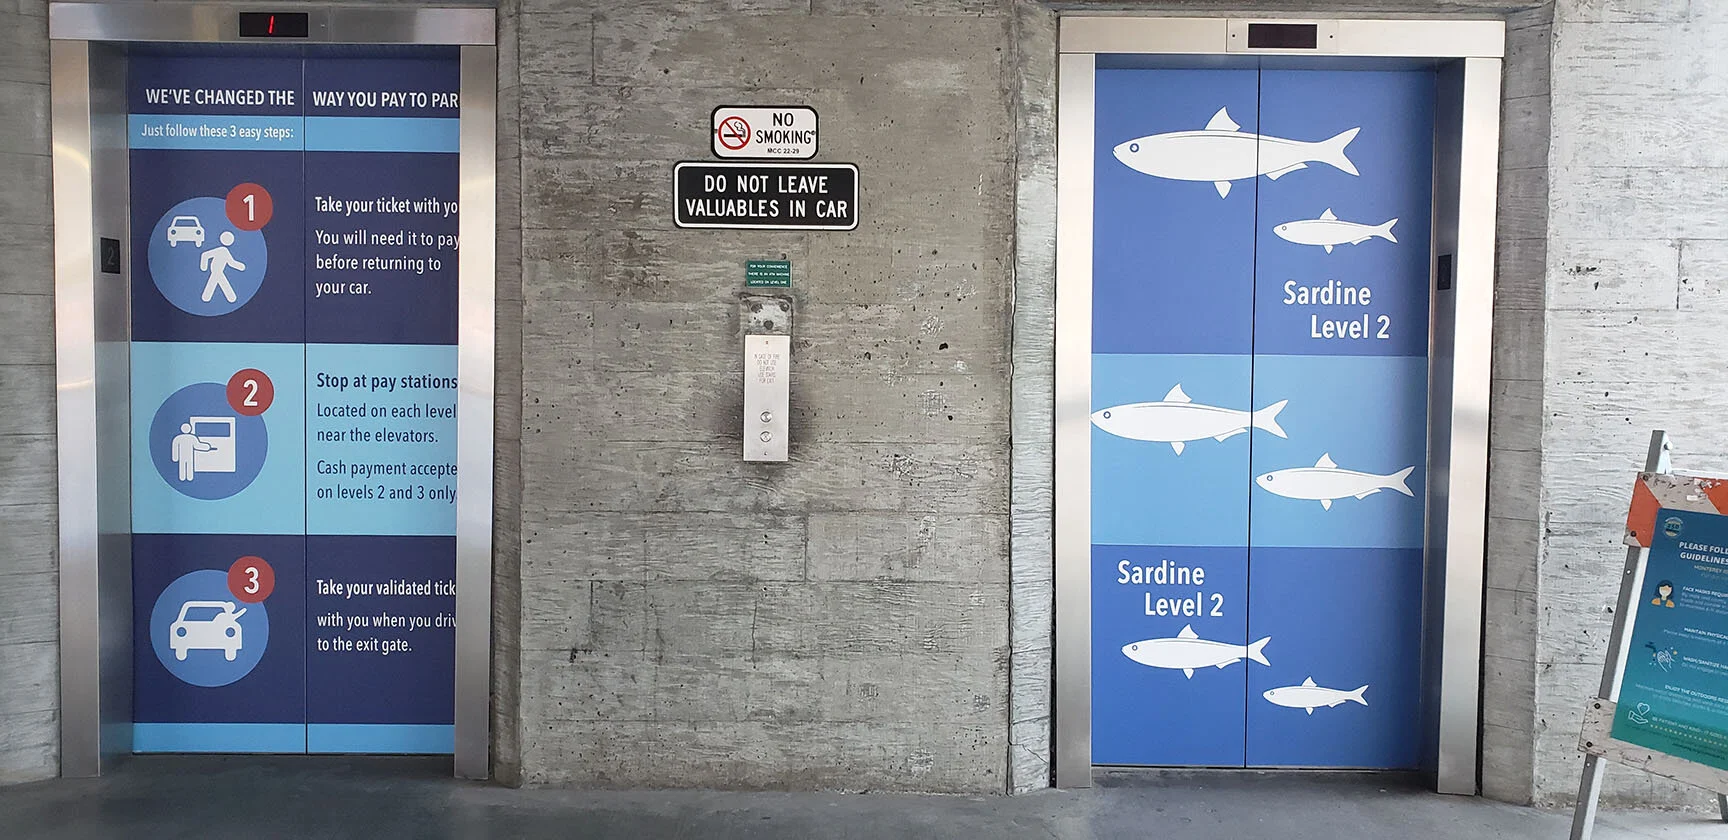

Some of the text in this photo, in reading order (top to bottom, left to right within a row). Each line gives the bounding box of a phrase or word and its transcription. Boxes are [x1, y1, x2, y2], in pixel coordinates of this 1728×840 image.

[267, 15, 275, 35] 1
[145, 88, 295, 106] WE'VE CHANGED THE
[312, 91, 458, 108] WAY YOU PAY TO PAR
[772, 112, 794, 127] NO
[141, 123, 294, 141] Just follow these 3 easy steps:
[755, 130, 811, 145] SMOKING
[704, 174, 828, 194] DO NOT LEAVE
[242, 194, 255, 221] 1
[315, 196, 458, 218] Take your ticket with yo
[685, 198, 848, 219] VALUABLES IN CAR
[315, 230, 460, 250] You will need it to pay
[316, 253, 441, 275] before returning to
[315, 282, 372, 298] your car.
[1283, 280, 1372, 306] Sardine
[1311, 313, 1391, 339] Level 2
[317, 372, 458, 392] Stop at pay stations
[243, 379, 258, 407] 2
[317, 402, 456, 418] Located on each level
[317, 427, 439, 443] near the elevators.
[317, 459, 458, 479] Cash payment accepte
[317, 487, 333, 499] on
[337, 484, 374, 499] levels
[377, 485, 385, 499] 2
[389, 484, 413, 499] and
[417, 485, 425, 500] 3
[1679, 541, 1708, 552] PLEASE
[243, 566, 260, 594] 3
[1117, 559, 1205, 586] Sardine
[316, 579, 456, 599] Take your validated tick
[1145, 591, 1224, 617] Level 2
[317, 611, 343, 627] with
[347, 615, 369, 631] you
[372, 611, 406, 627] when
[409, 615, 431, 631] you
[317, 635, 412, 656] to the exit gate.
